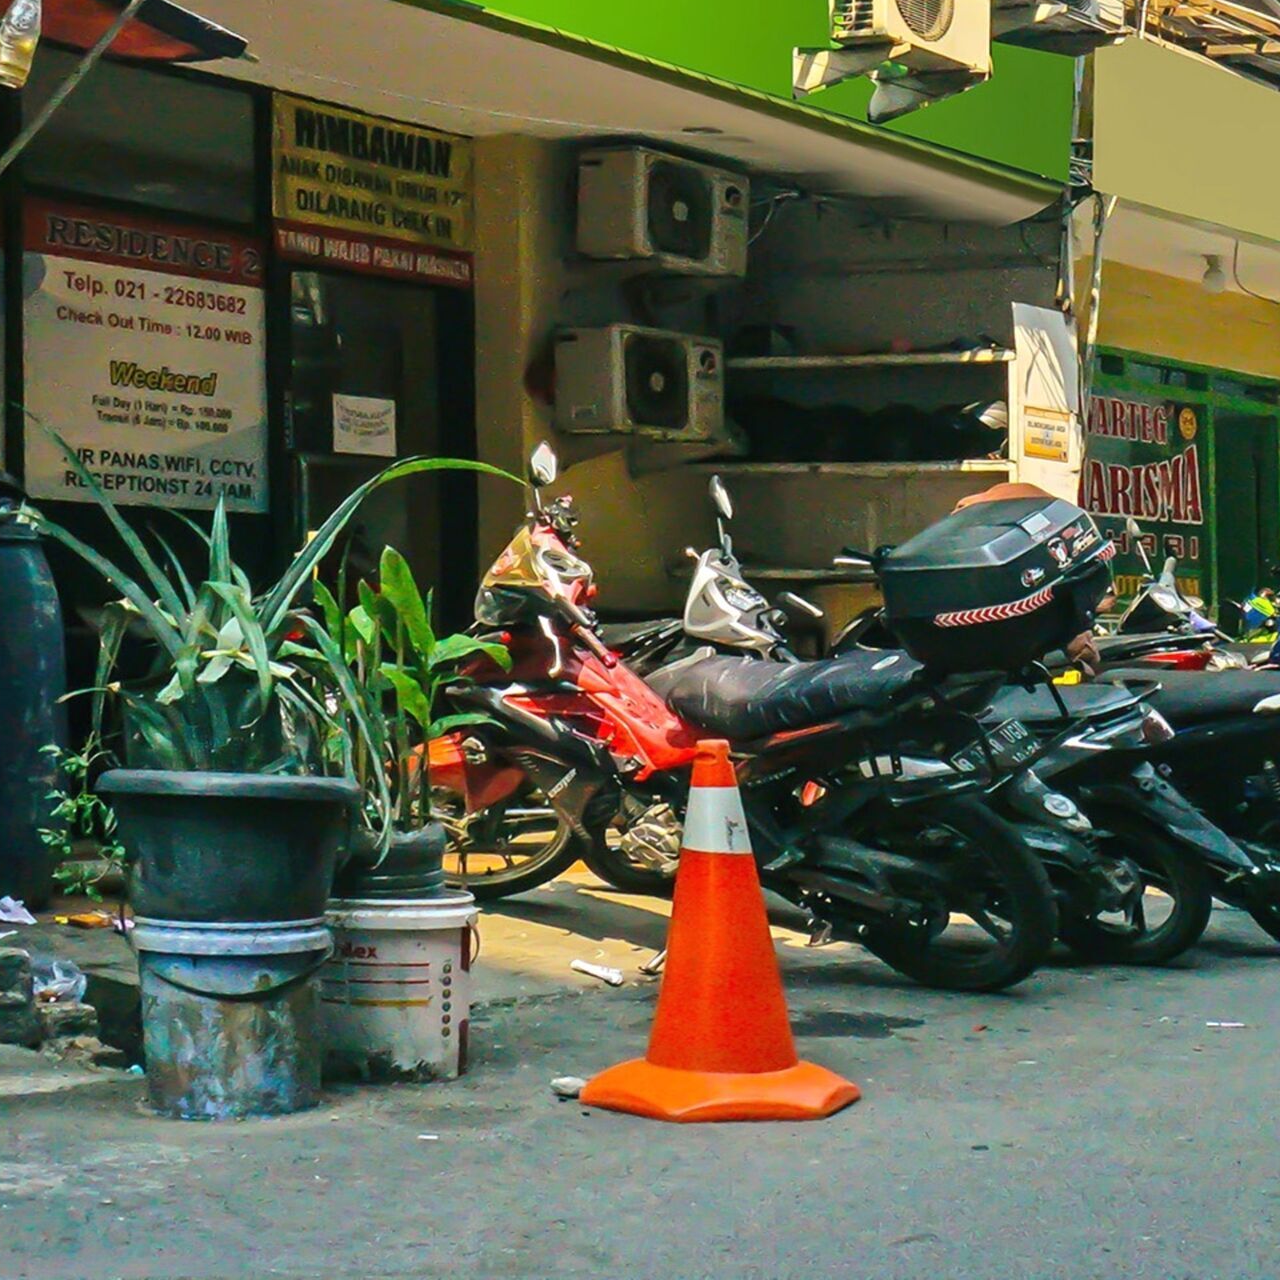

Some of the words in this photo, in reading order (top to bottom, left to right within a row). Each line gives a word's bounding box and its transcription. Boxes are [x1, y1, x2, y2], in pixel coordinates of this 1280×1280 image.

[296, 188, 385, 225] DILARANG
[47, 214, 232, 272] RESIDENCE
[279, 230, 320, 256] TAMU
[63, 271, 110, 297] Telp.
[114, 279, 146, 300] 021
[56, 305, 104, 325] Check
[108, 313, 135, 330] Out
[139, 317, 172, 335] Time
[225, 329, 253, 345] WIB
[109, 360, 218, 397] Weekend
[195, 482, 213, 496] 24
